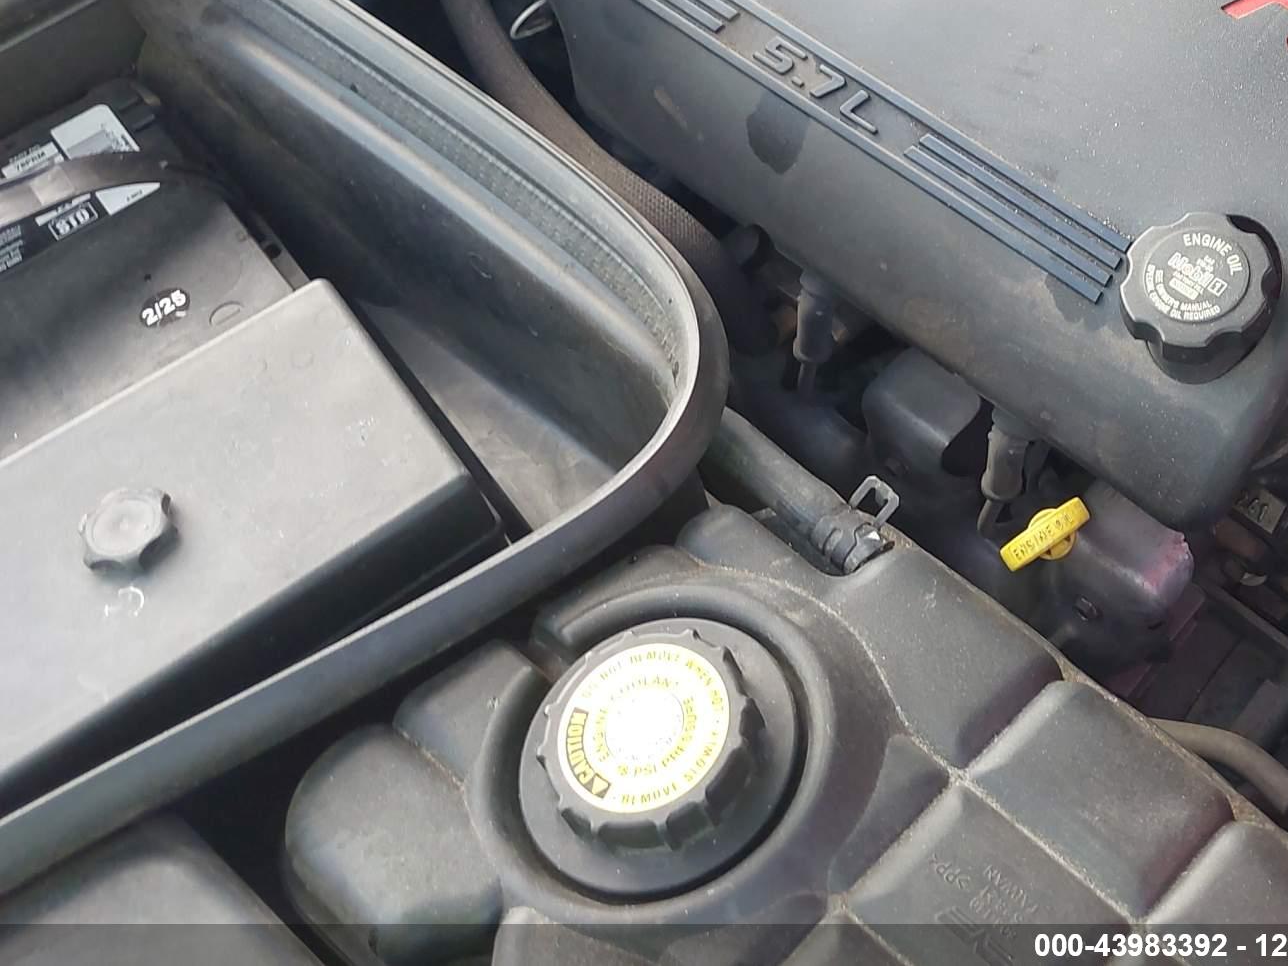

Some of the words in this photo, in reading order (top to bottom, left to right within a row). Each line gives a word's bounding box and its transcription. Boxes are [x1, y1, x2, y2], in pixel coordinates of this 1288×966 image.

[1167, 252, 1216, 286] Mobil
[1183, 232, 1232, 257] ENGINE
[1226, 254, 1243, 275] OIL
[1170, 310, 1182, 319] OIL
[1184, 305, 1221, 321] REQUIRED
[1180, 300, 1213, 311] MANUAL
[1012, 525, 1053, 560] ENGINE
[567, 712, 595, 786] CAUTION
